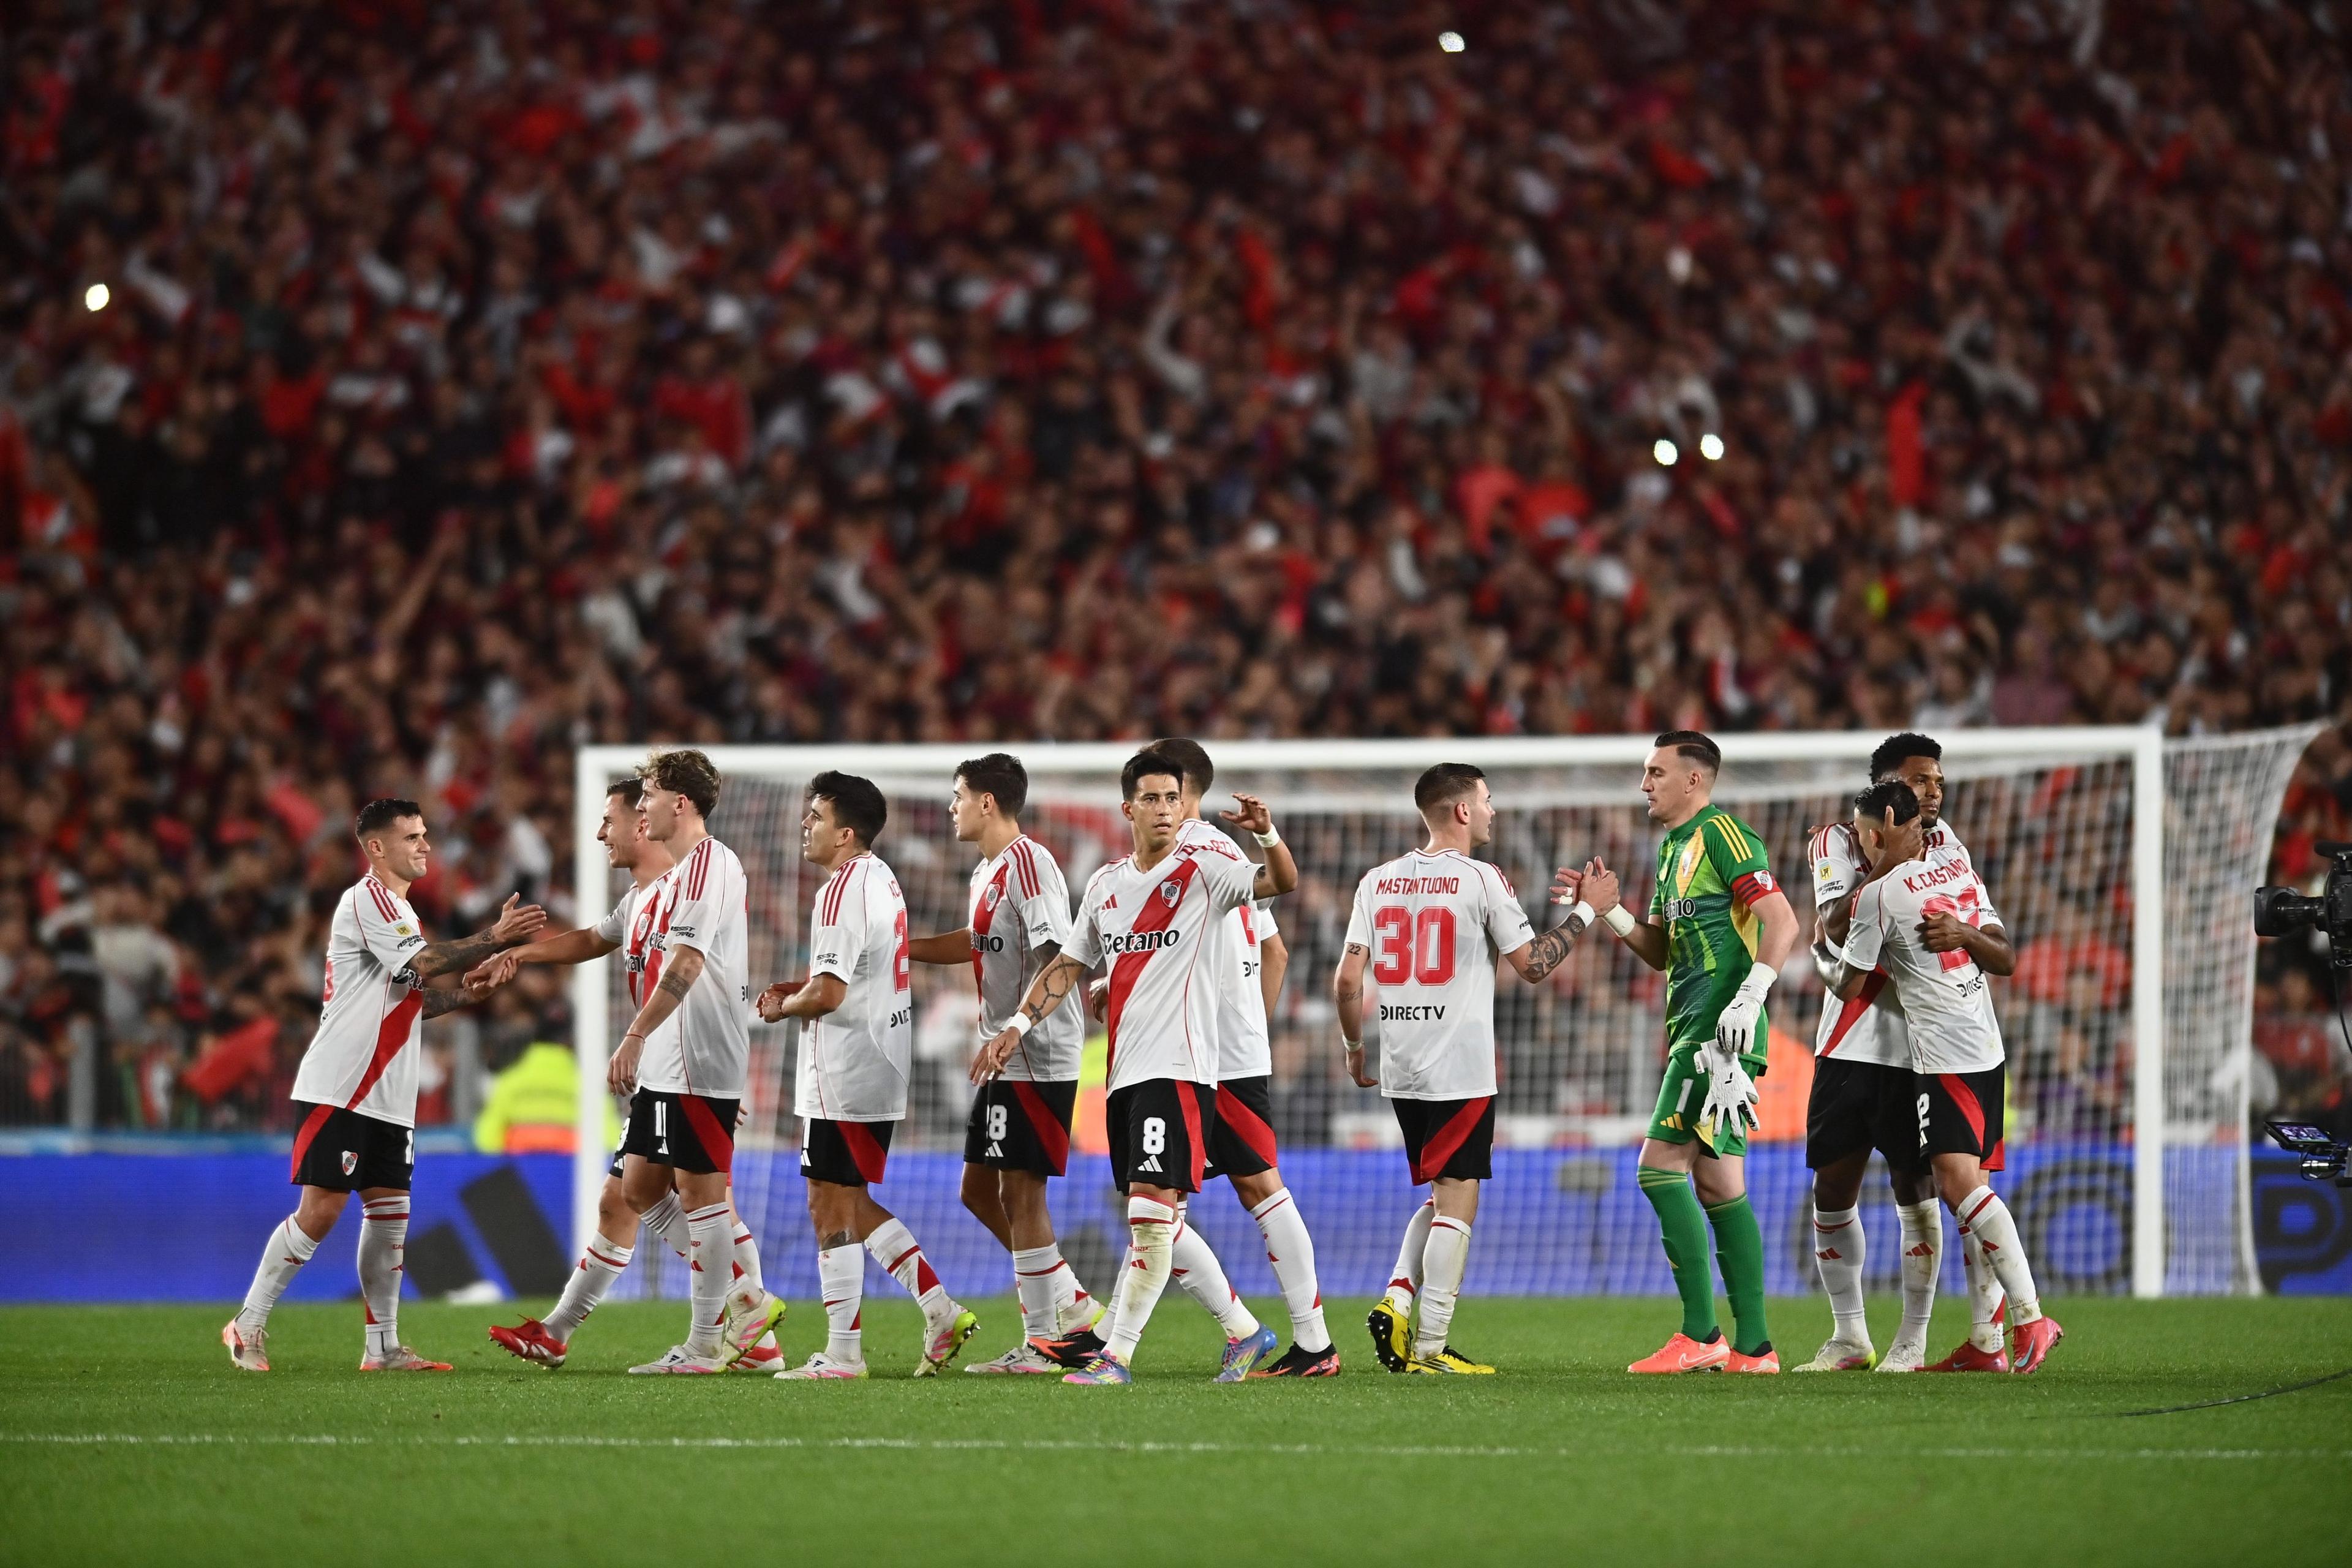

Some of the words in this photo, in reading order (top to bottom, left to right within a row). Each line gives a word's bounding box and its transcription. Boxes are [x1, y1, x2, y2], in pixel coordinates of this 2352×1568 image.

[1376, 876, 1460, 895] MASTANTUONO
[397, 935, 421, 950] ASSIS
[1102, 929, 1180, 956] Betano
[1348, 944, 1361, 956] 22
[1374, 905, 1457, 986] 30
[1380, 1005, 1446, 1020] DIRECTV
[1675, 1078, 1694, 1114] 1
[986, 1104, 1008, 1141] 8
[1142, 1117, 1166, 1155] 8
